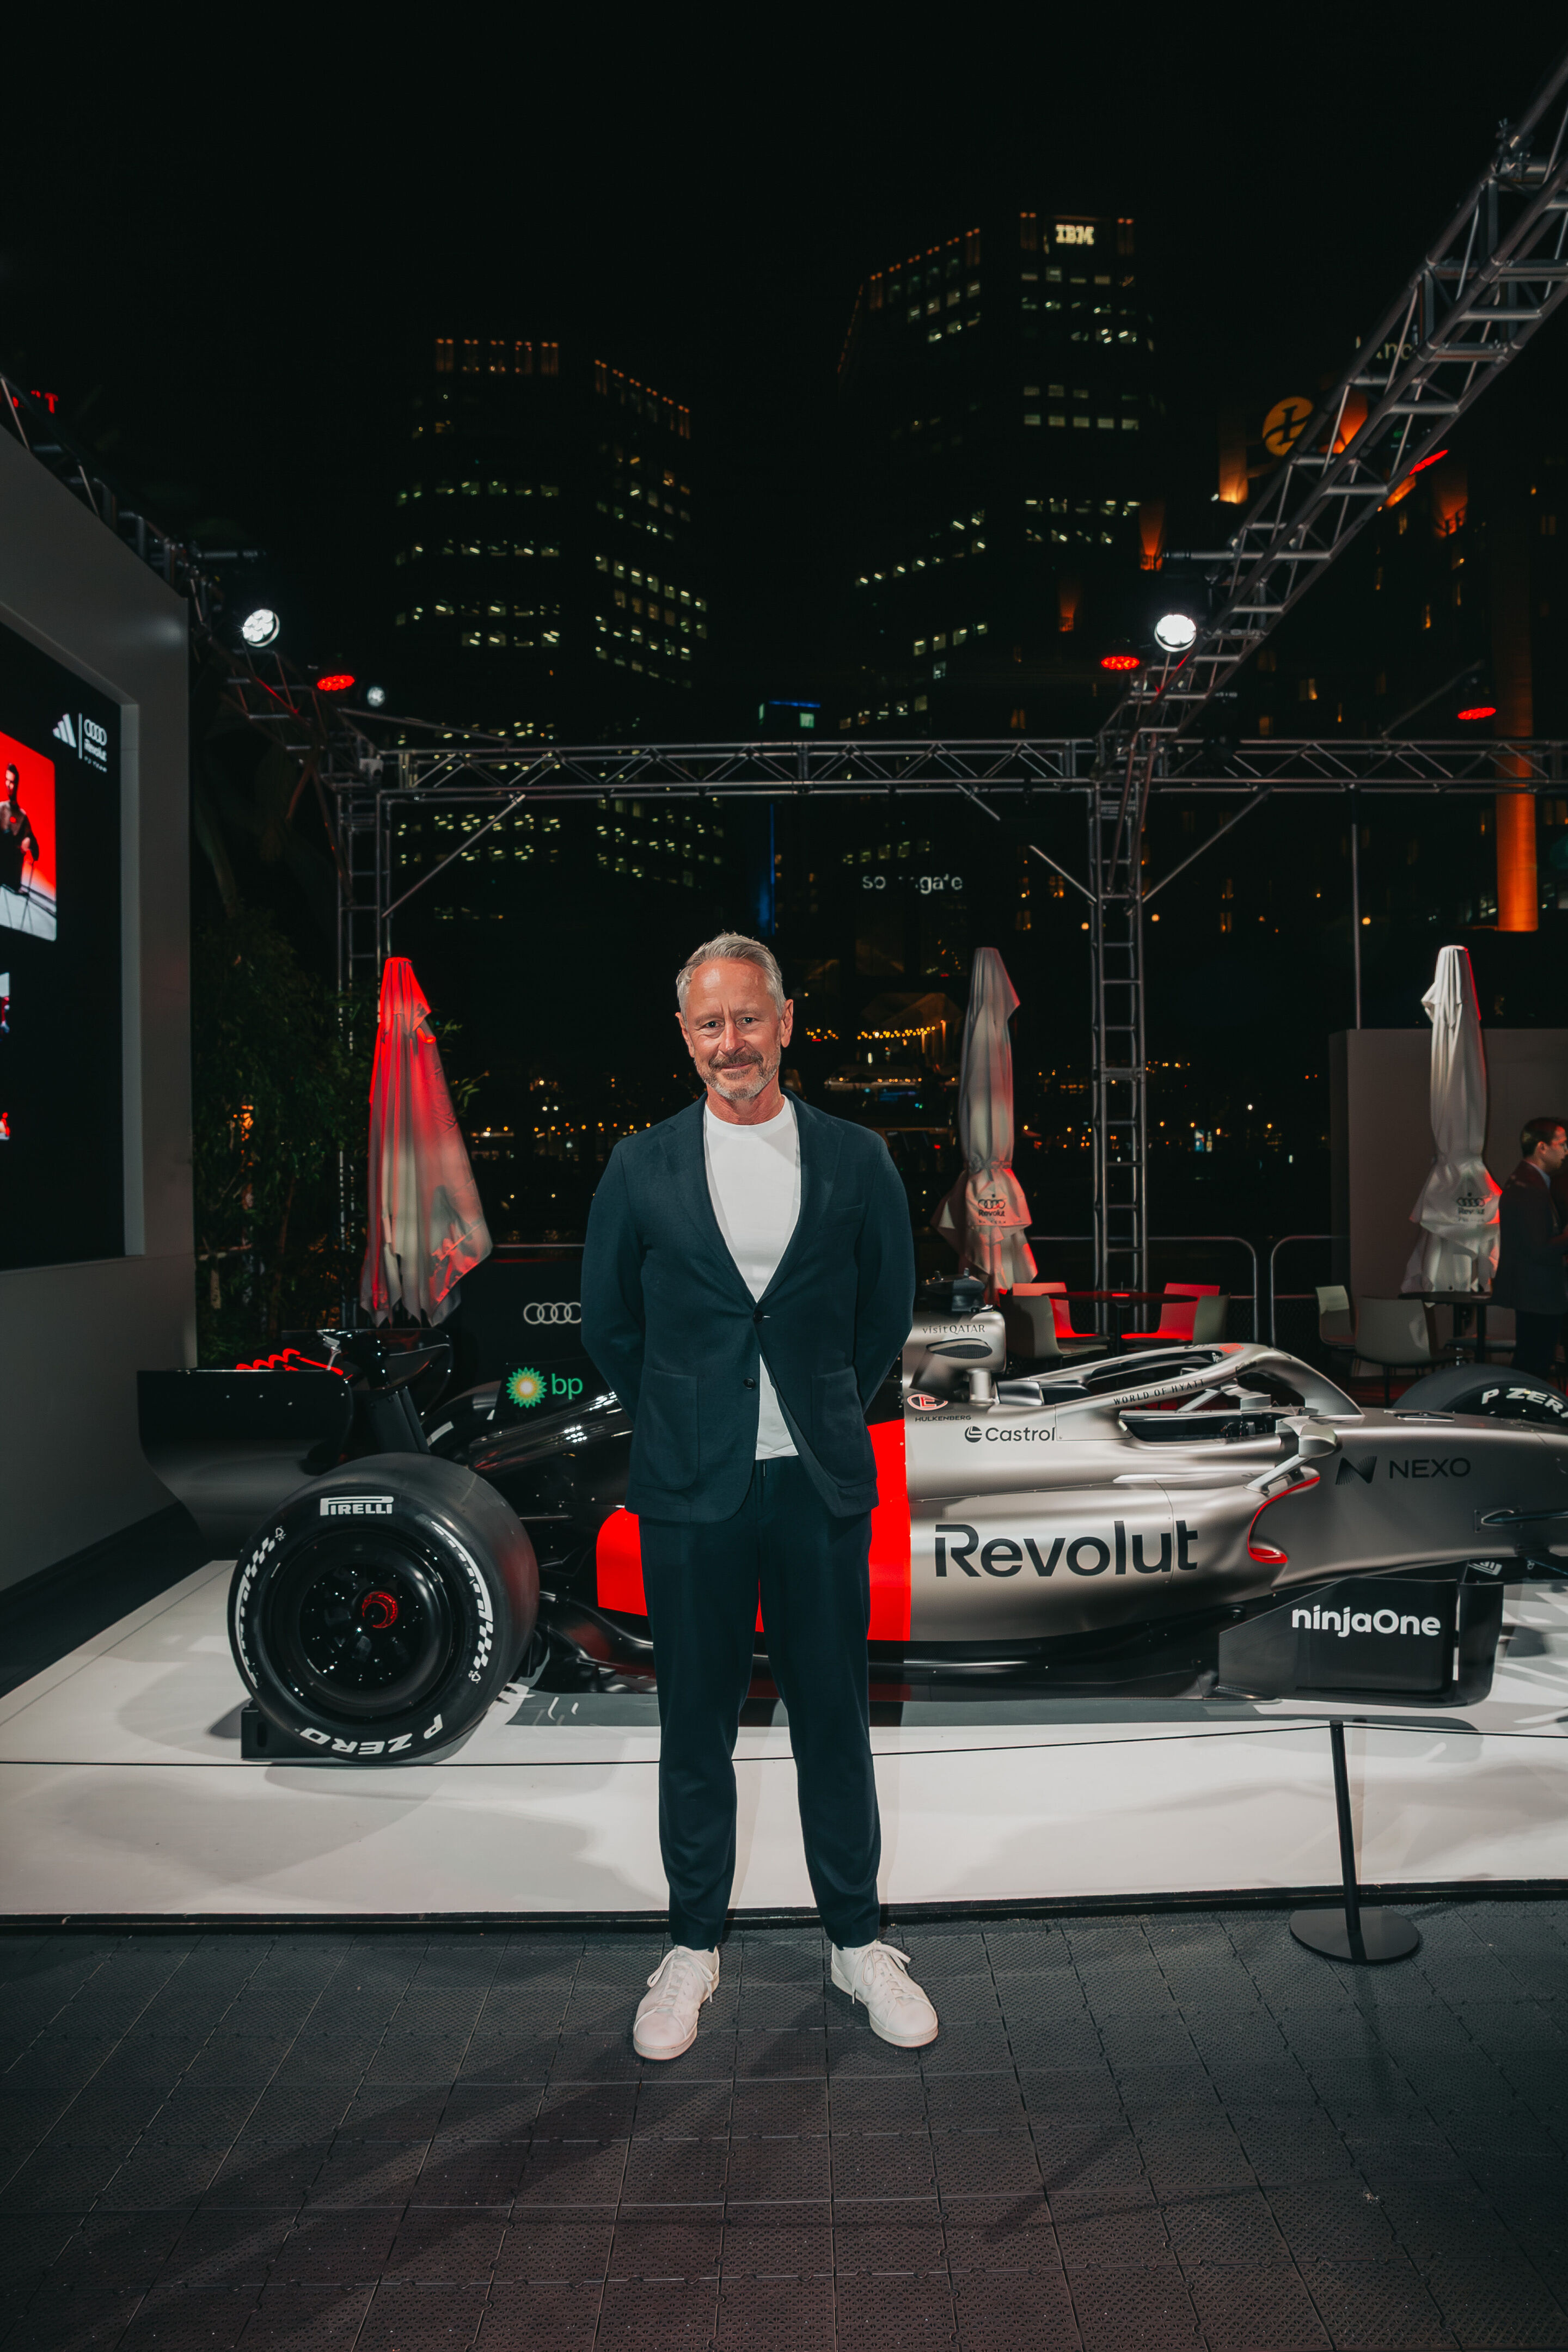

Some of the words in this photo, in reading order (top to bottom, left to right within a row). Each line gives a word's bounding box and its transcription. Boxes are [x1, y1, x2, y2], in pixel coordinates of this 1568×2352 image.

[1055, 224, 1094, 244] IBM
[922, 1324, 986, 1334] visitQATAR
[551, 1373, 583, 1400] bp
[1113, 1391, 1150, 1406] WORLD
[1154, 1387, 1167, 1397] OF
[1171, 1379, 1205, 1394] HYATT
[1481, 1388, 1500, 1405] P
[985, 1426, 1055, 1442] Castrol
[1389, 1456, 1471, 1479] NEXO
[320, 1496, 394, 1516] PIRELLI
[934, 1520, 1199, 1578] Revolut
[1291, 1604, 1442, 1638] ninjaOne
[423, 1713, 444, 1739] P
[299, 1727, 413, 1755] ZERO
